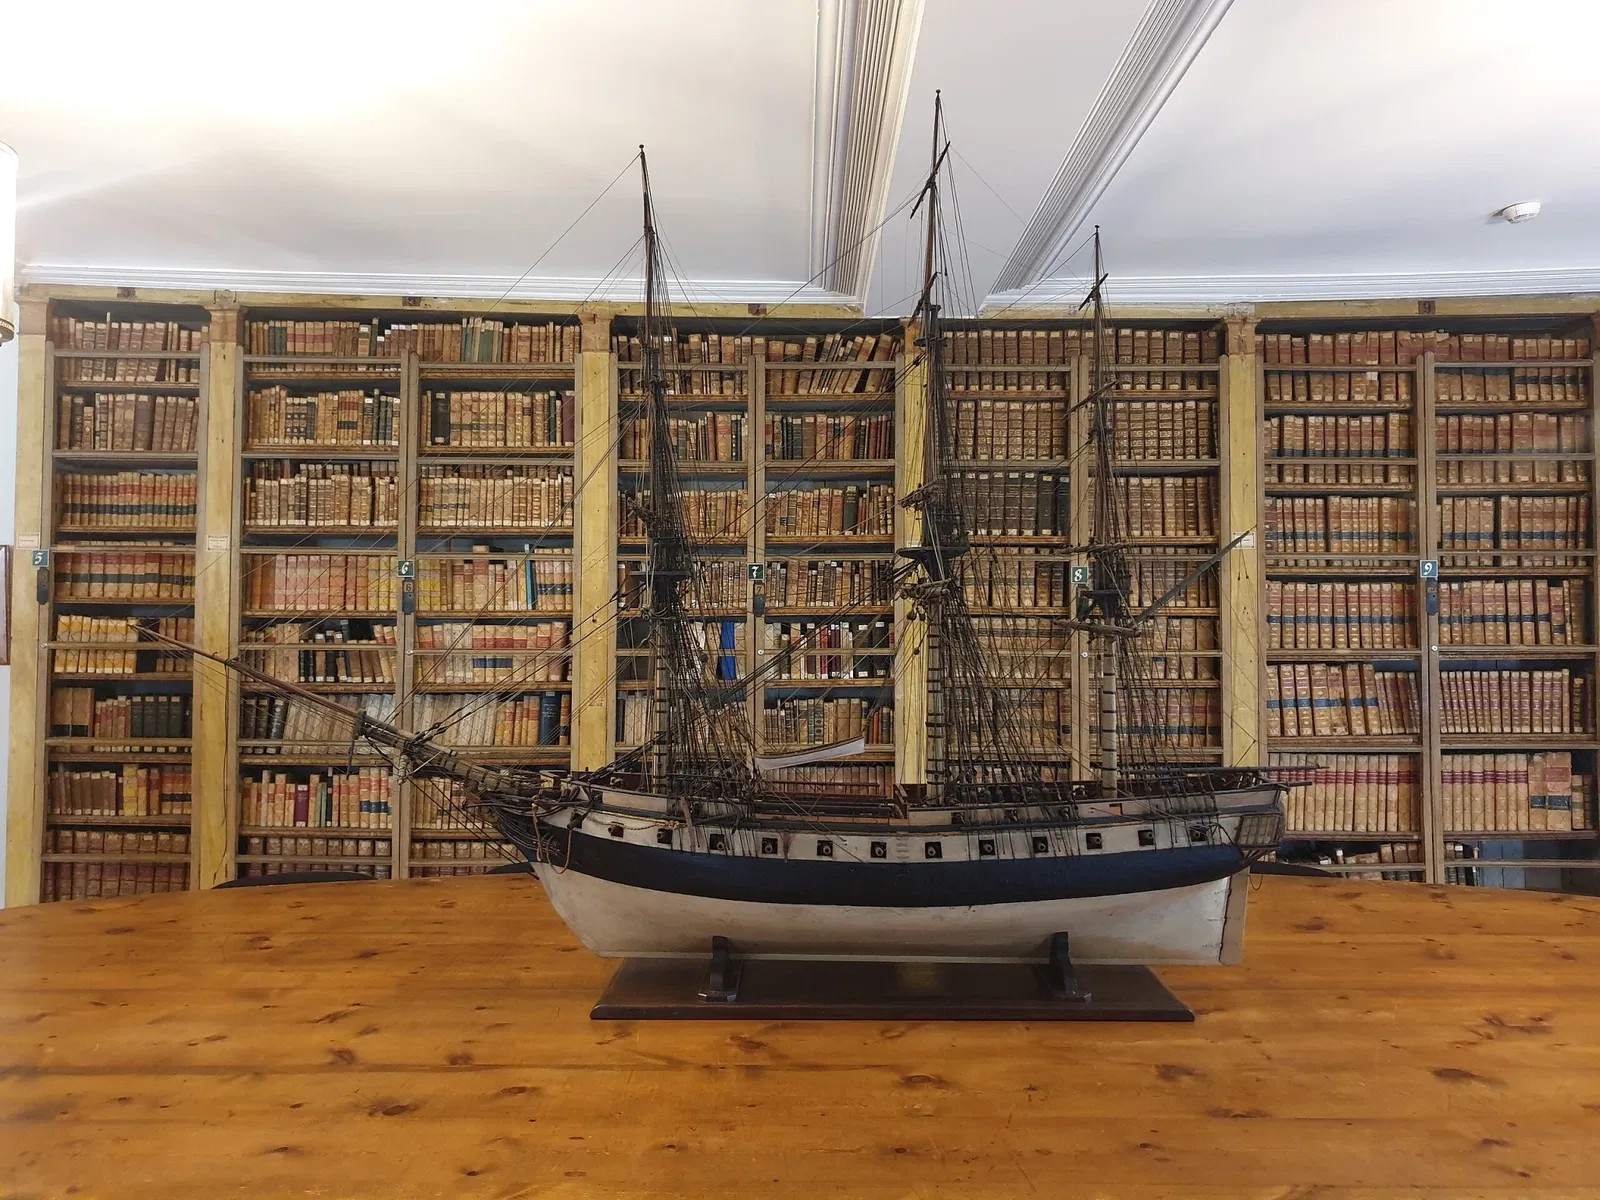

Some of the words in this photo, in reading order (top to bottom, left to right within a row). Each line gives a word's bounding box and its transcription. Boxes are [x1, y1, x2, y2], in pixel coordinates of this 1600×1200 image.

[1423, 301, 1431, 314] 9
[34, 551, 43, 565] 5
[401, 561, 410, 575] 6
[751, 565, 760, 579] 7
[1074, 568, 1083, 582] 8
[1423, 562, 1433, 576] 9
[405, 583, 412, 591] 6
